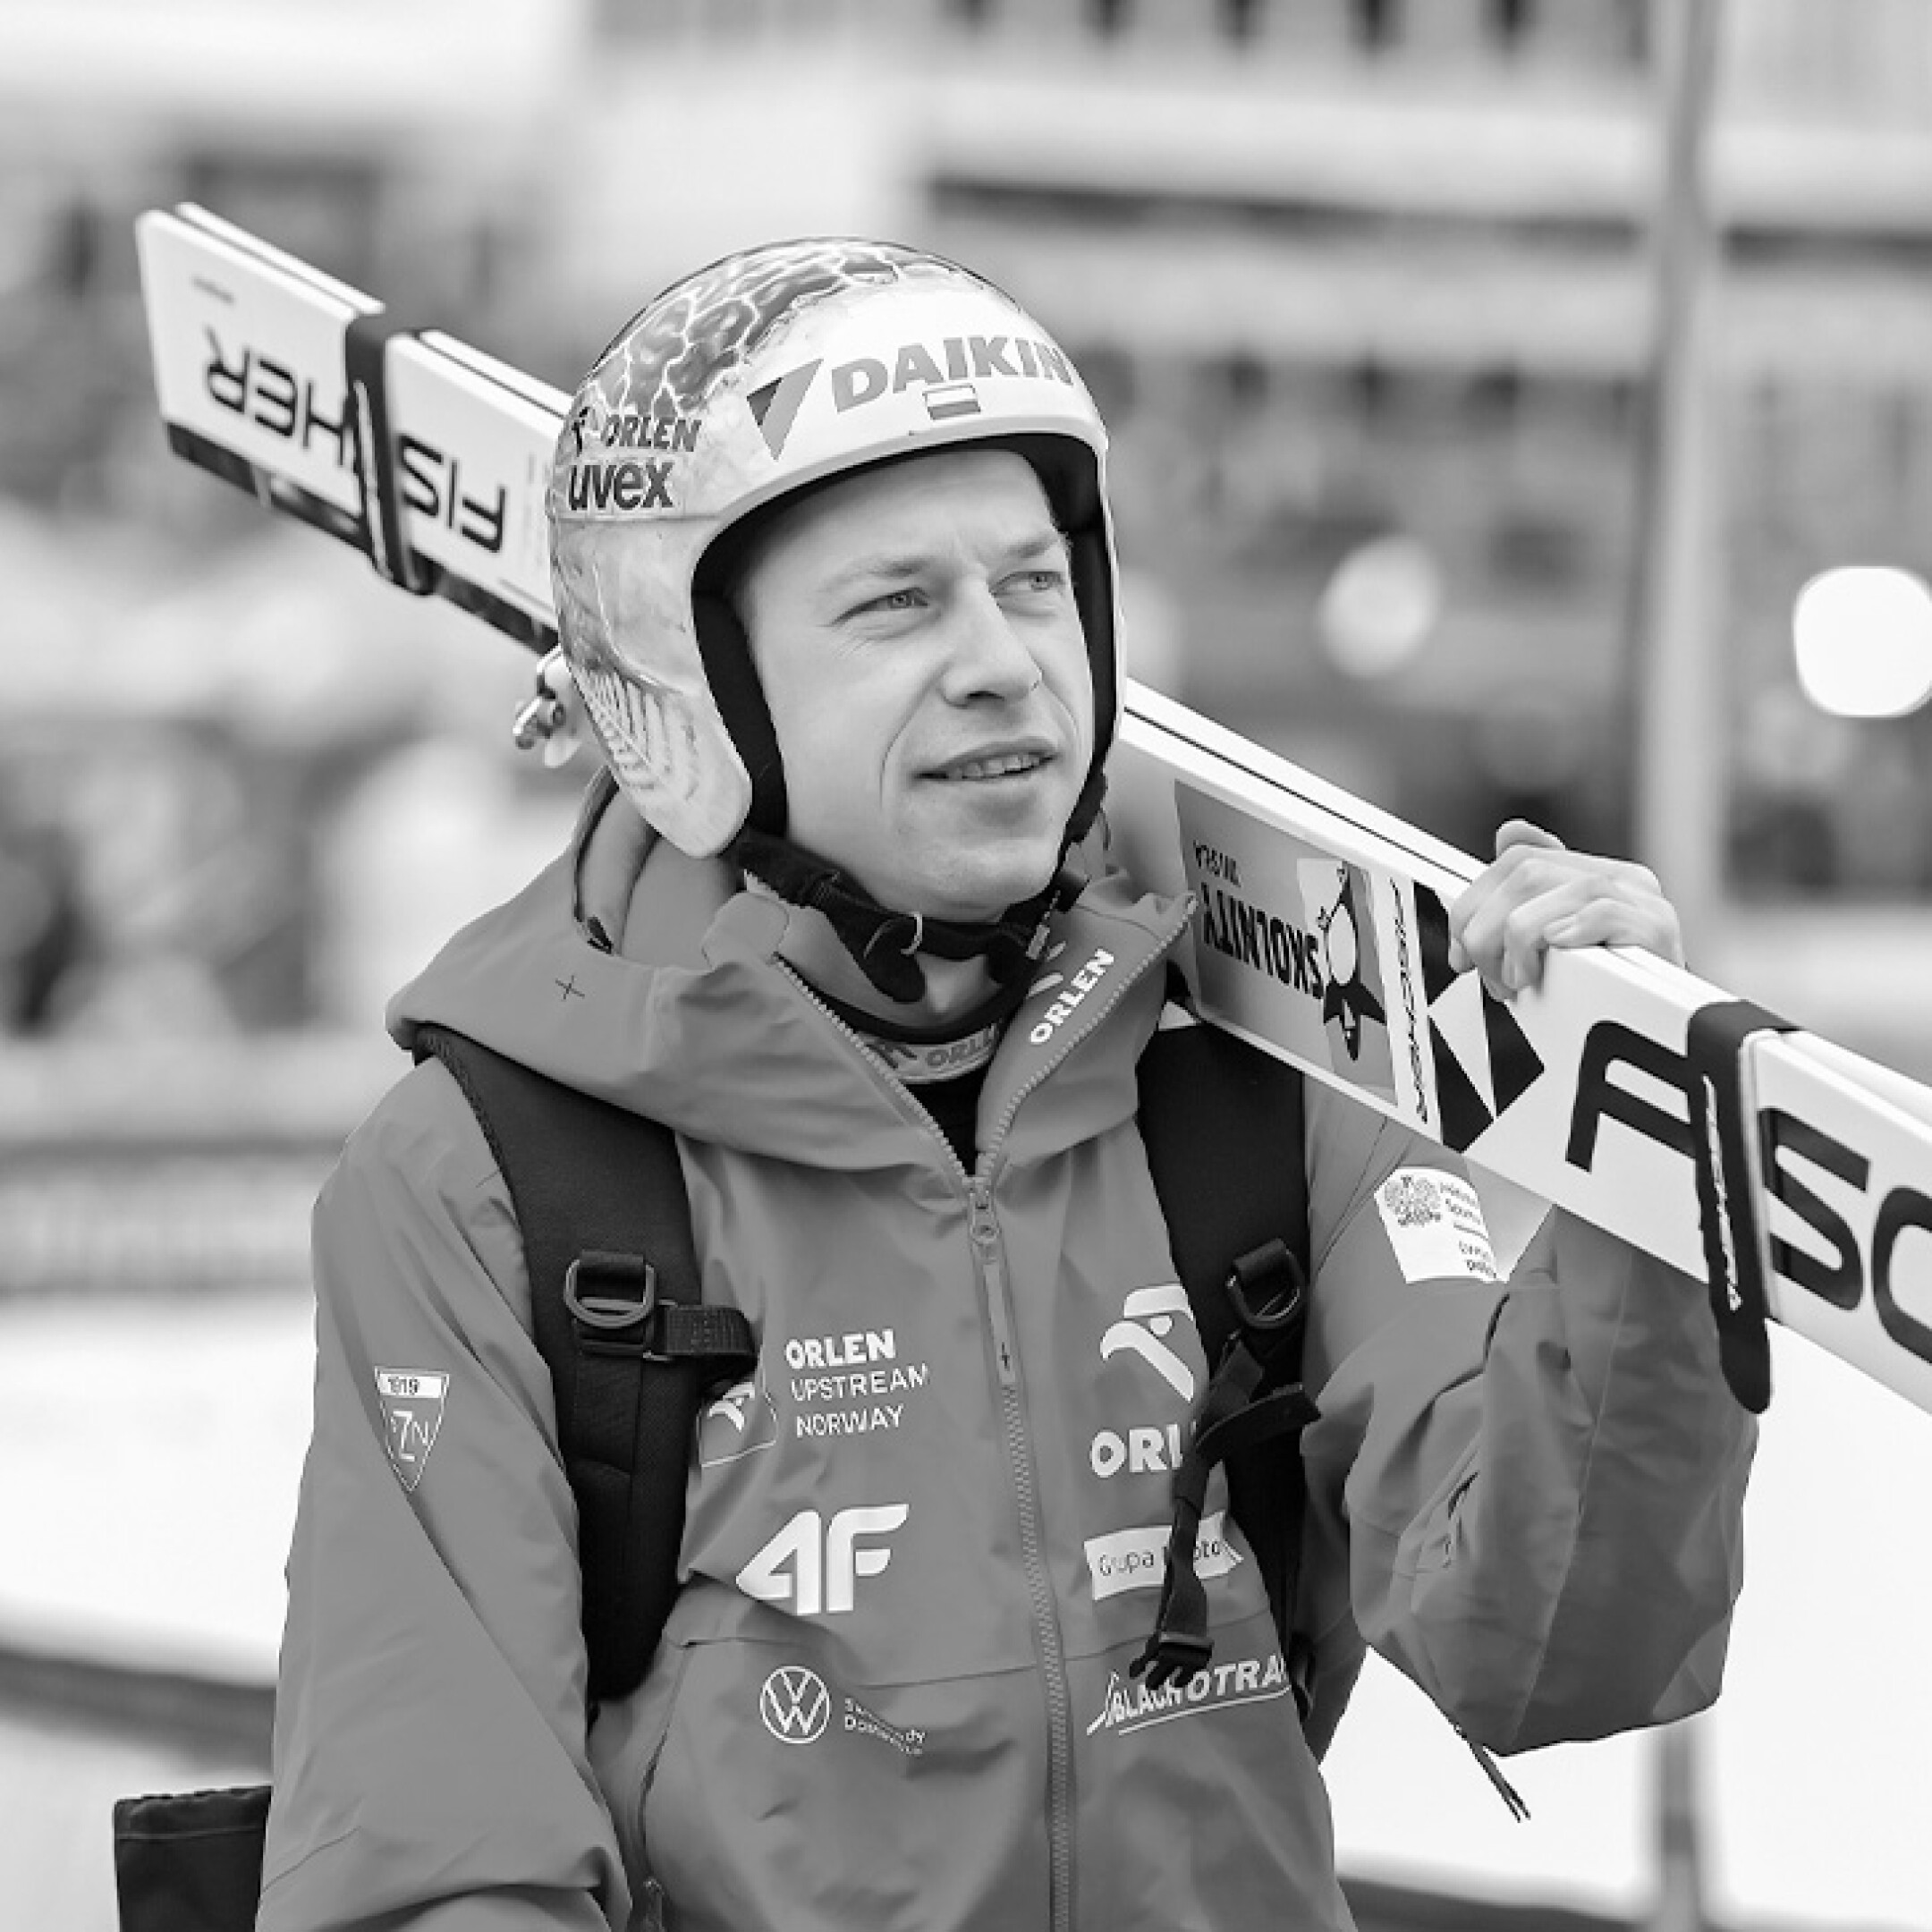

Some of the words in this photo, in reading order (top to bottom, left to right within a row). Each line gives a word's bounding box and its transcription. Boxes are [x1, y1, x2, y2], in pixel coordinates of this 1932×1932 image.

[831, 335, 1073, 413] DAIKIN
[203, 325, 508, 555] FISHER
[601, 414, 702, 453] ORLEN
[568, 460, 674, 512] uvex
[1030, 947, 1114, 1045] ORLEN
[784, 1327, 895, 1370] ORLEN
[796, 1402, 904, 1438] NORWAY
[1089, 1422, 1184, 1479] ORL
[735, 1503, 911, 1616] 4F
